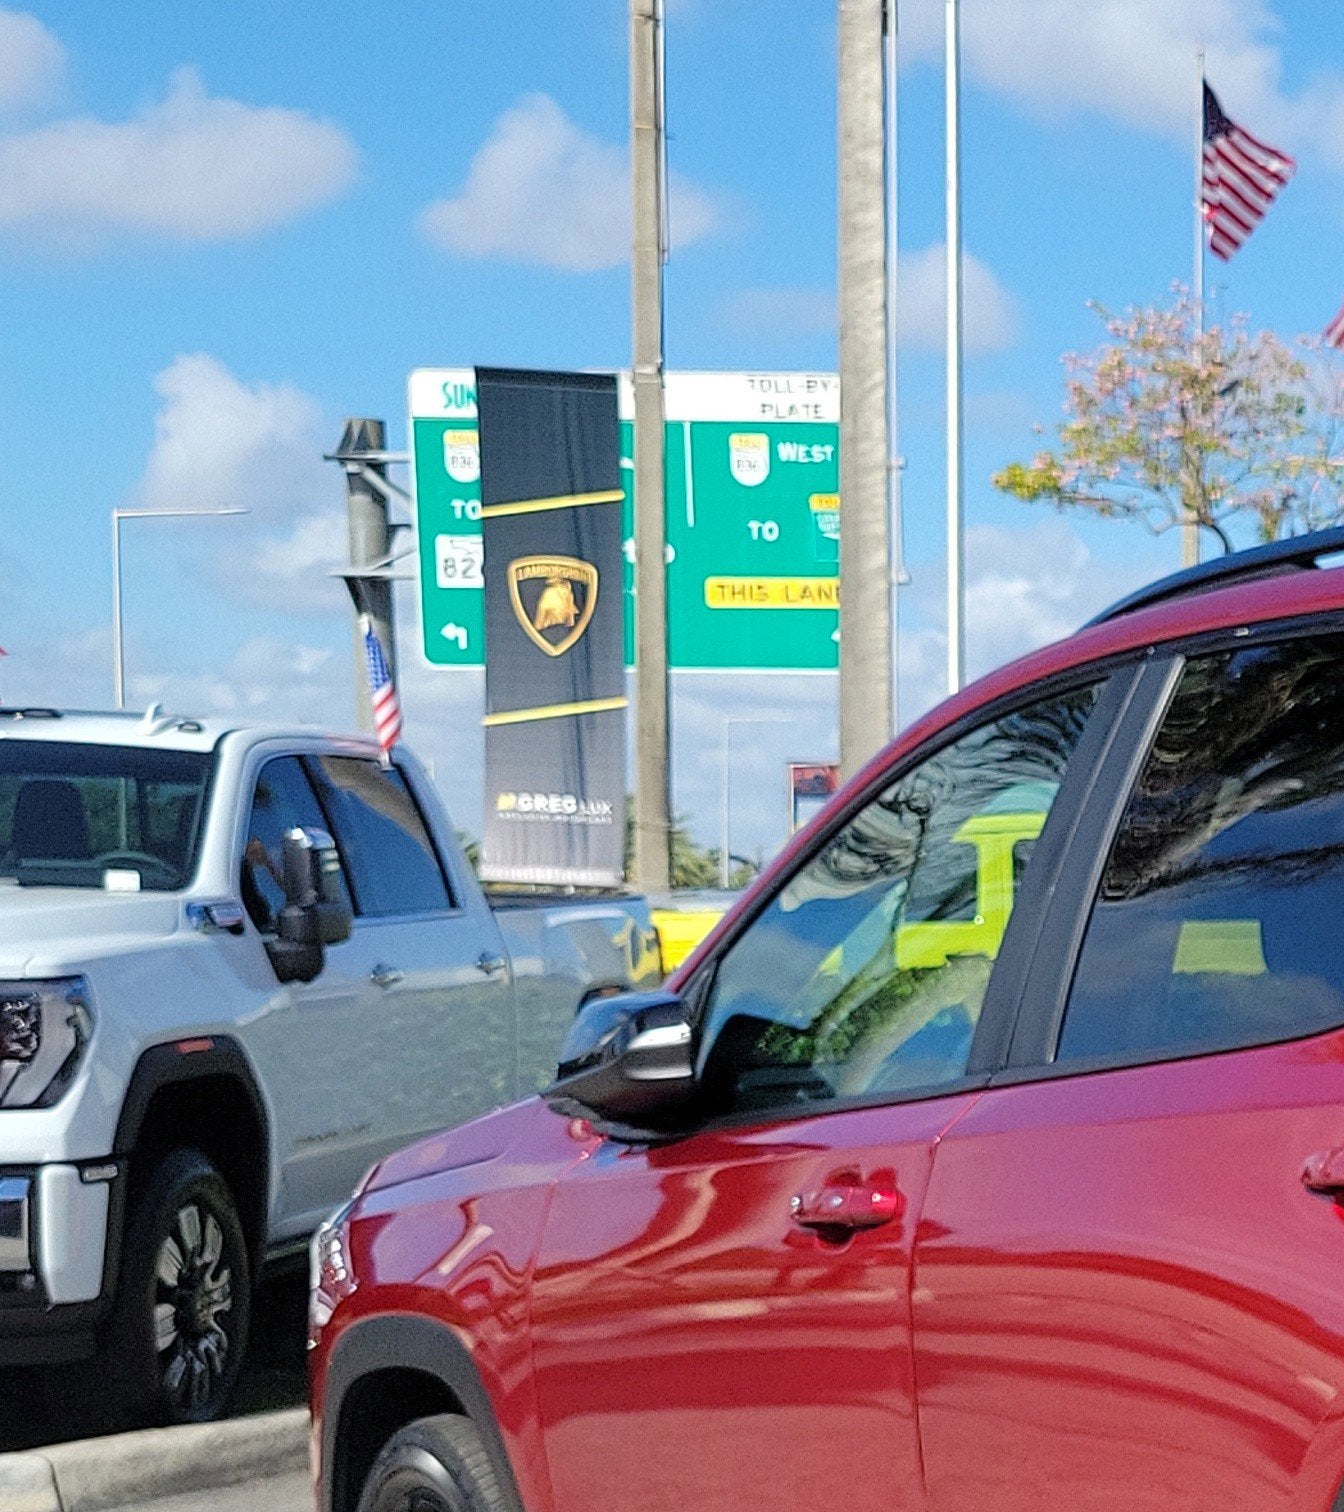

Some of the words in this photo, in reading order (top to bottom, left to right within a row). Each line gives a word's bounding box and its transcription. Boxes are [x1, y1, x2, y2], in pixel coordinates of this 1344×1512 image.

[760, 402, 826, 419] PLATE
[777, 441, 834, 463] WEST
[450, 498, 482, 521] TO
[747, 519, 780, 542] TO
[717, 584, 769, 602] THIS
